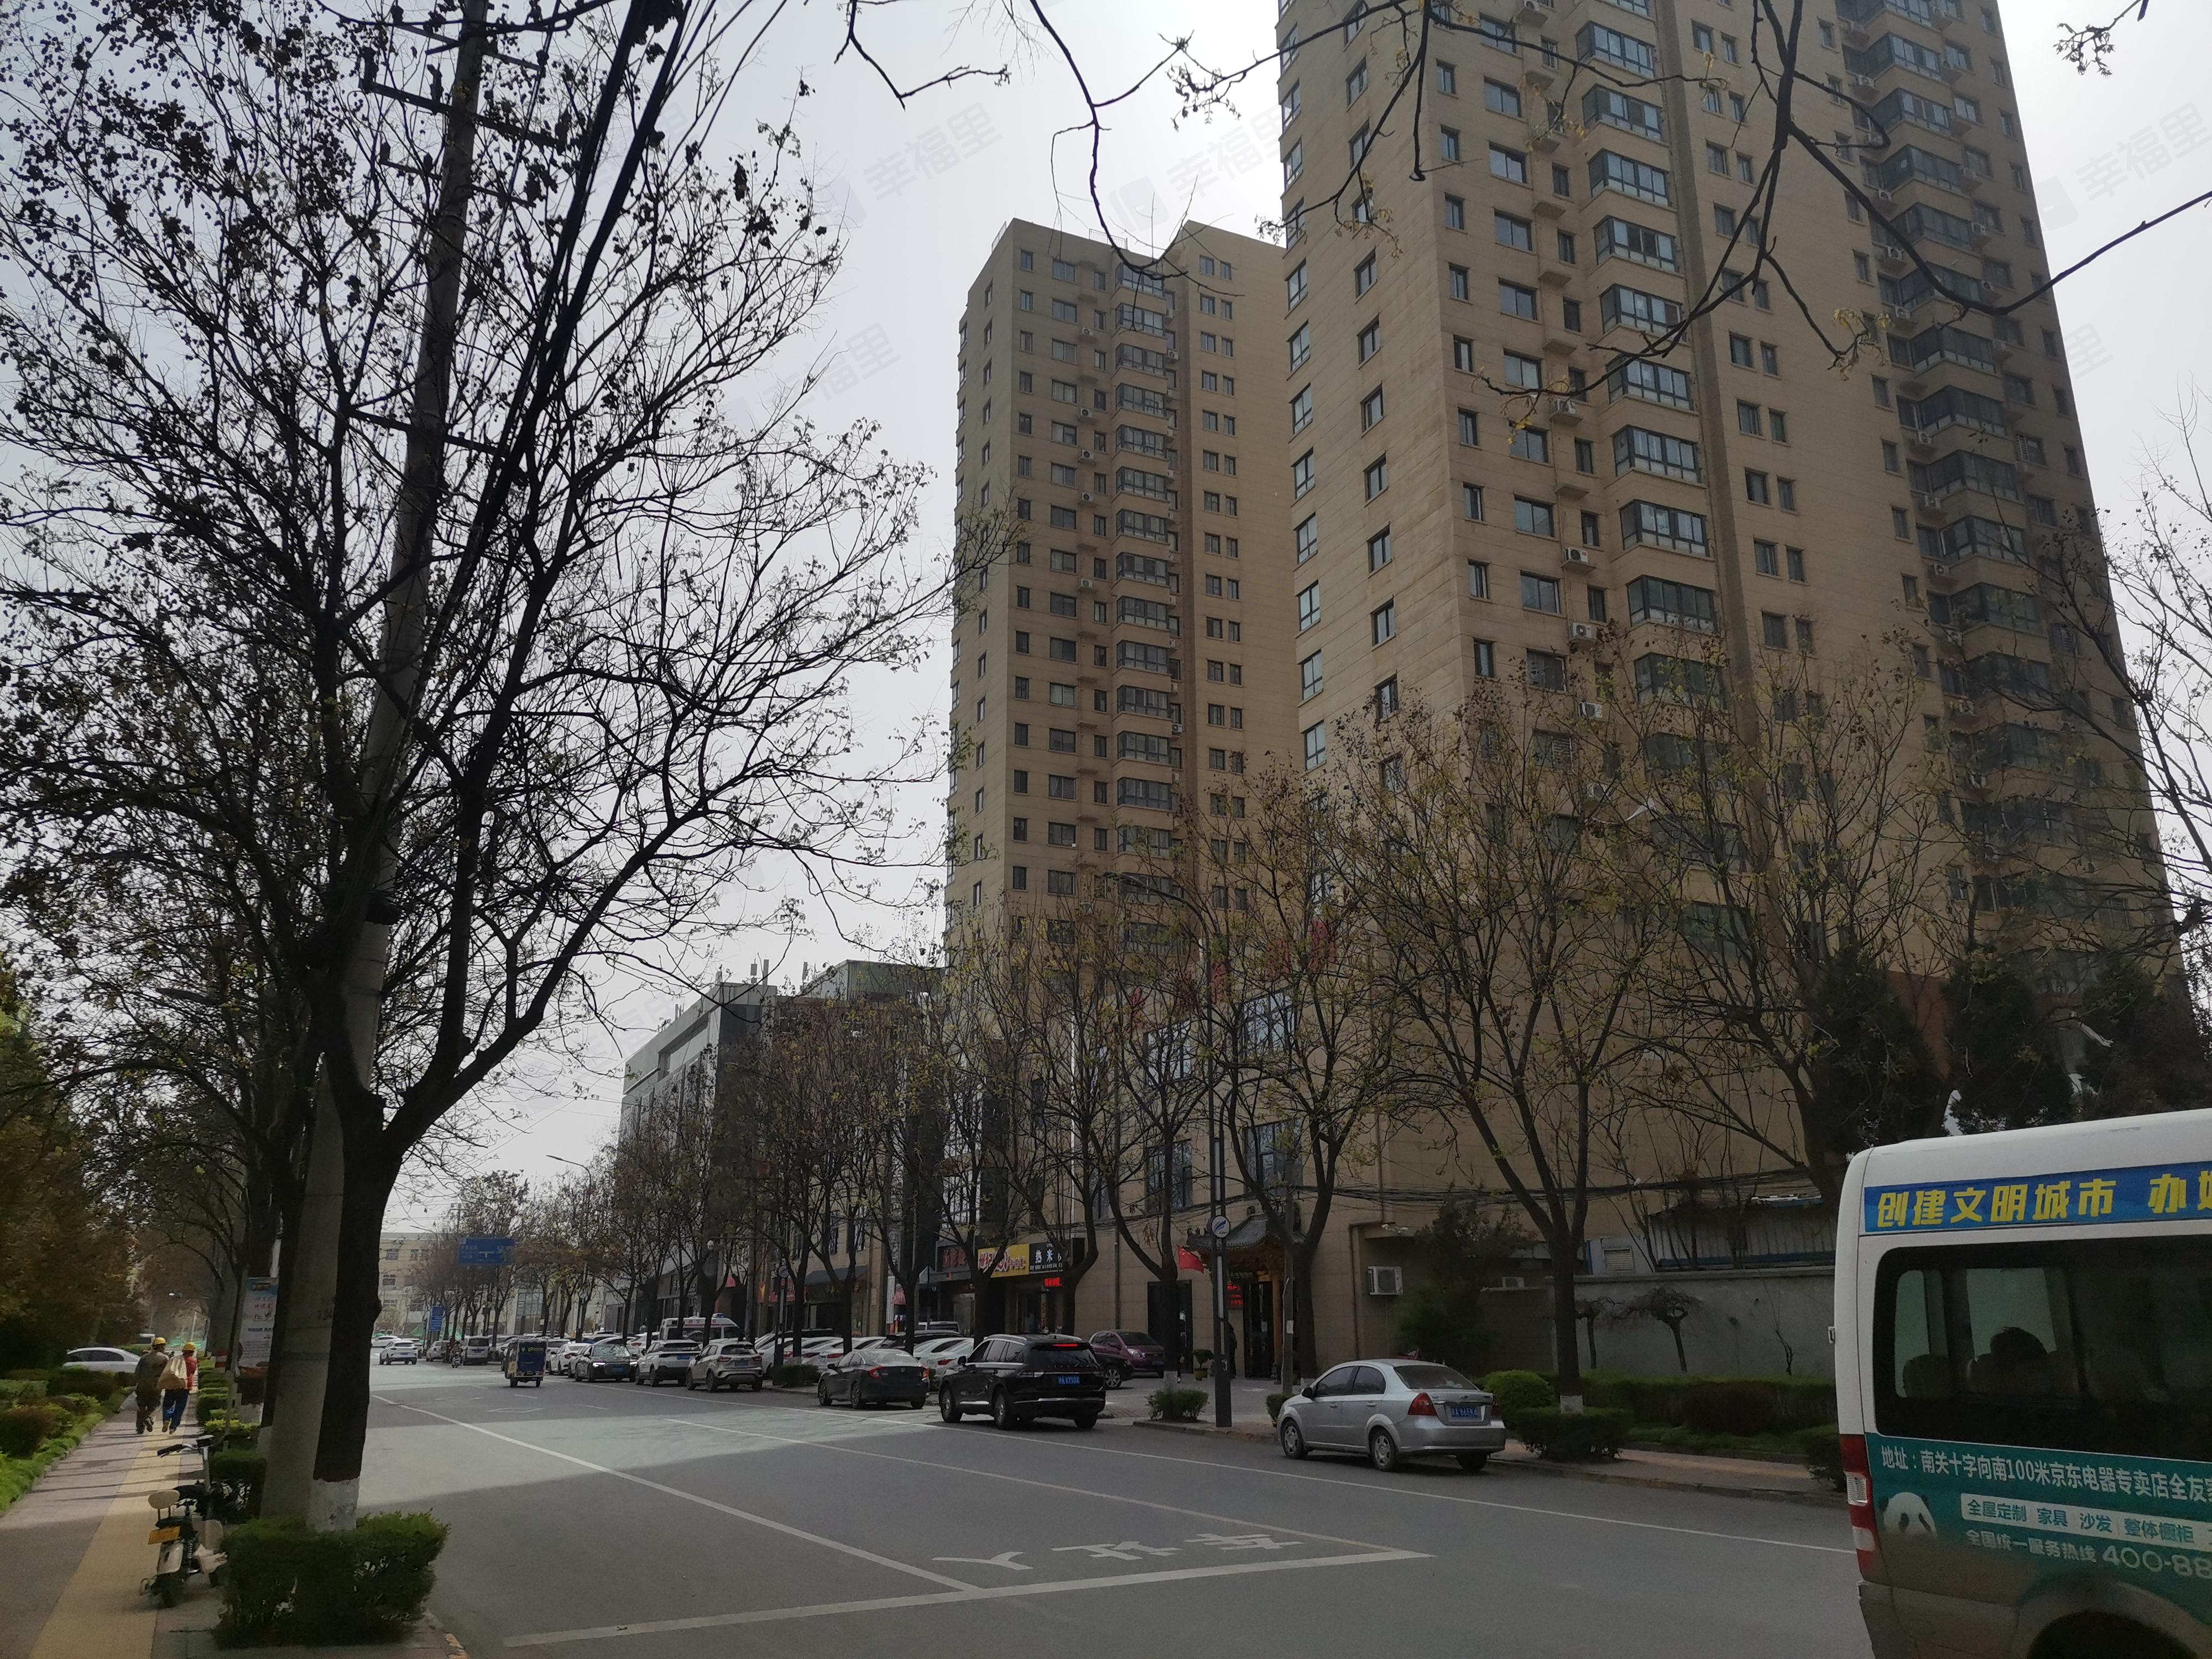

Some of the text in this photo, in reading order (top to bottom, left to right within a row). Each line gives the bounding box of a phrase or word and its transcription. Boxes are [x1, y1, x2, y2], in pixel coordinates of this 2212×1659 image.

[1877, 1179, 2116, 1227] 创建文明城市
[1967, 1499, 2027, 1522] 全屋定制
[2037, 1507, 2068, 1528] 家具
[2079, 1512, 2112, 1533] 沙发
[2124, 1518, 2194, 1543] 整体橱柜
[1966, 1529, 2098, 1564] 全国统一服务热线
